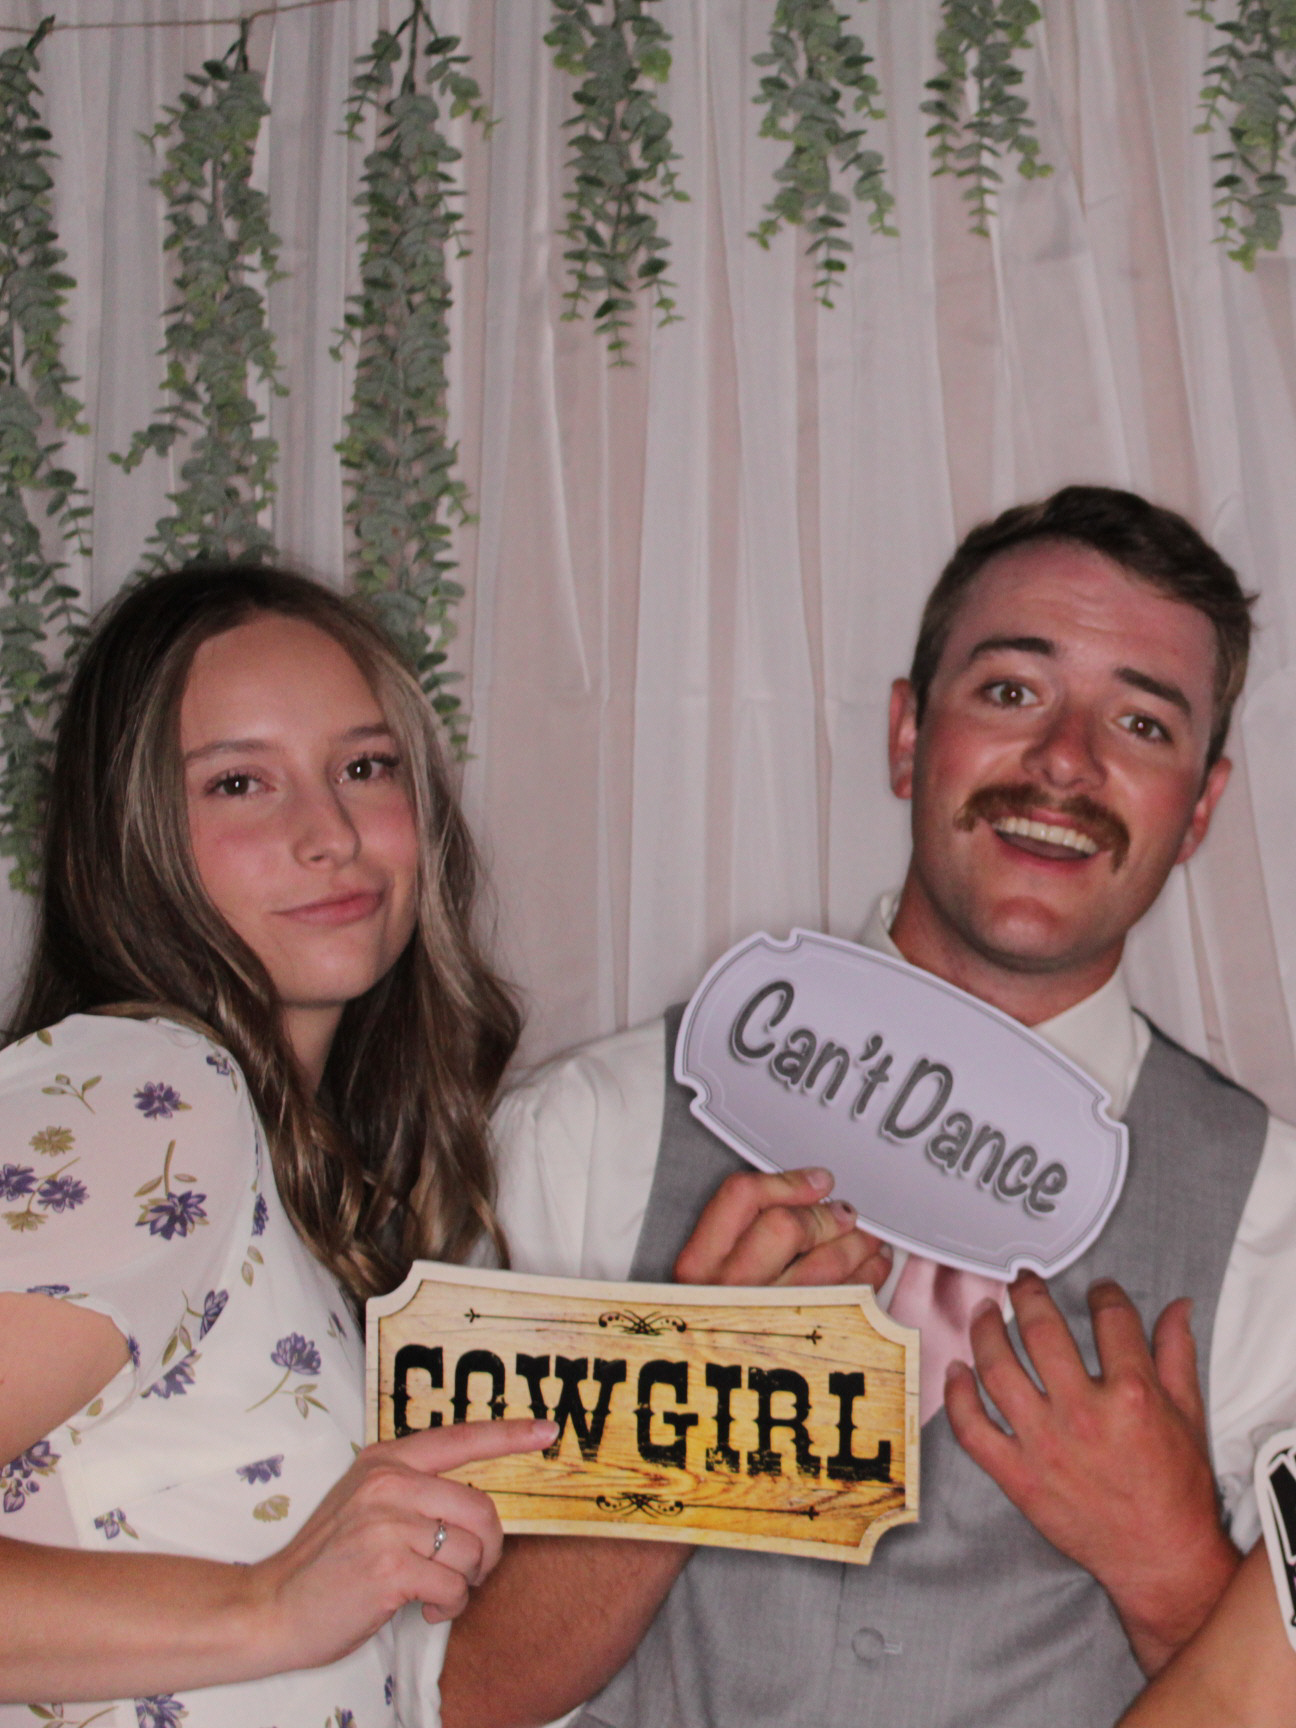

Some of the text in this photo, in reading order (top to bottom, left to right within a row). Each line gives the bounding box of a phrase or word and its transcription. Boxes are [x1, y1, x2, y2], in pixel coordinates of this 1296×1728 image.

[731, 980, 1068, 1214] Can't Dance
[392, 1343, 891, 1483] COWGIRL
